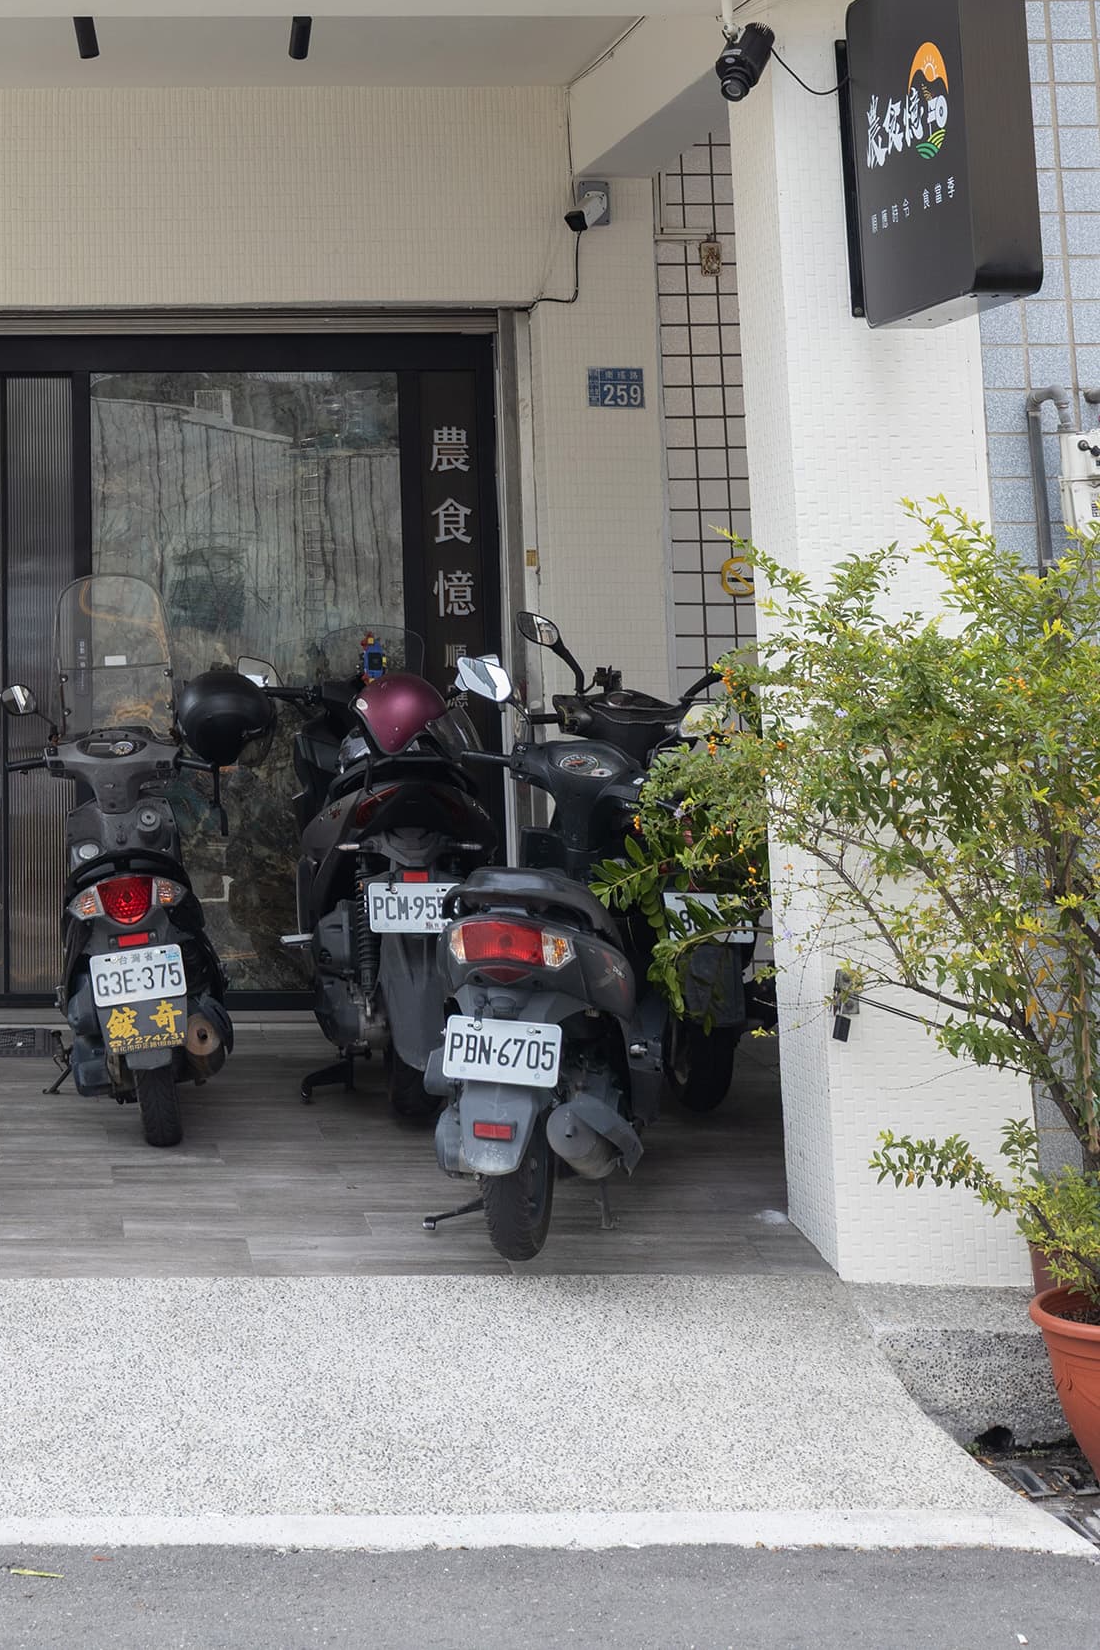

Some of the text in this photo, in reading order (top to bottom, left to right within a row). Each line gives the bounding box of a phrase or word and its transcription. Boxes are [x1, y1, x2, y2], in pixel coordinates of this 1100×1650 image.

[866, 87, 924, 169] 農食憶
[603, 384, 641, 406] 259
[430, 426, 476, 617] 農食憶
[119, 951, 153, 965] 台灣省
